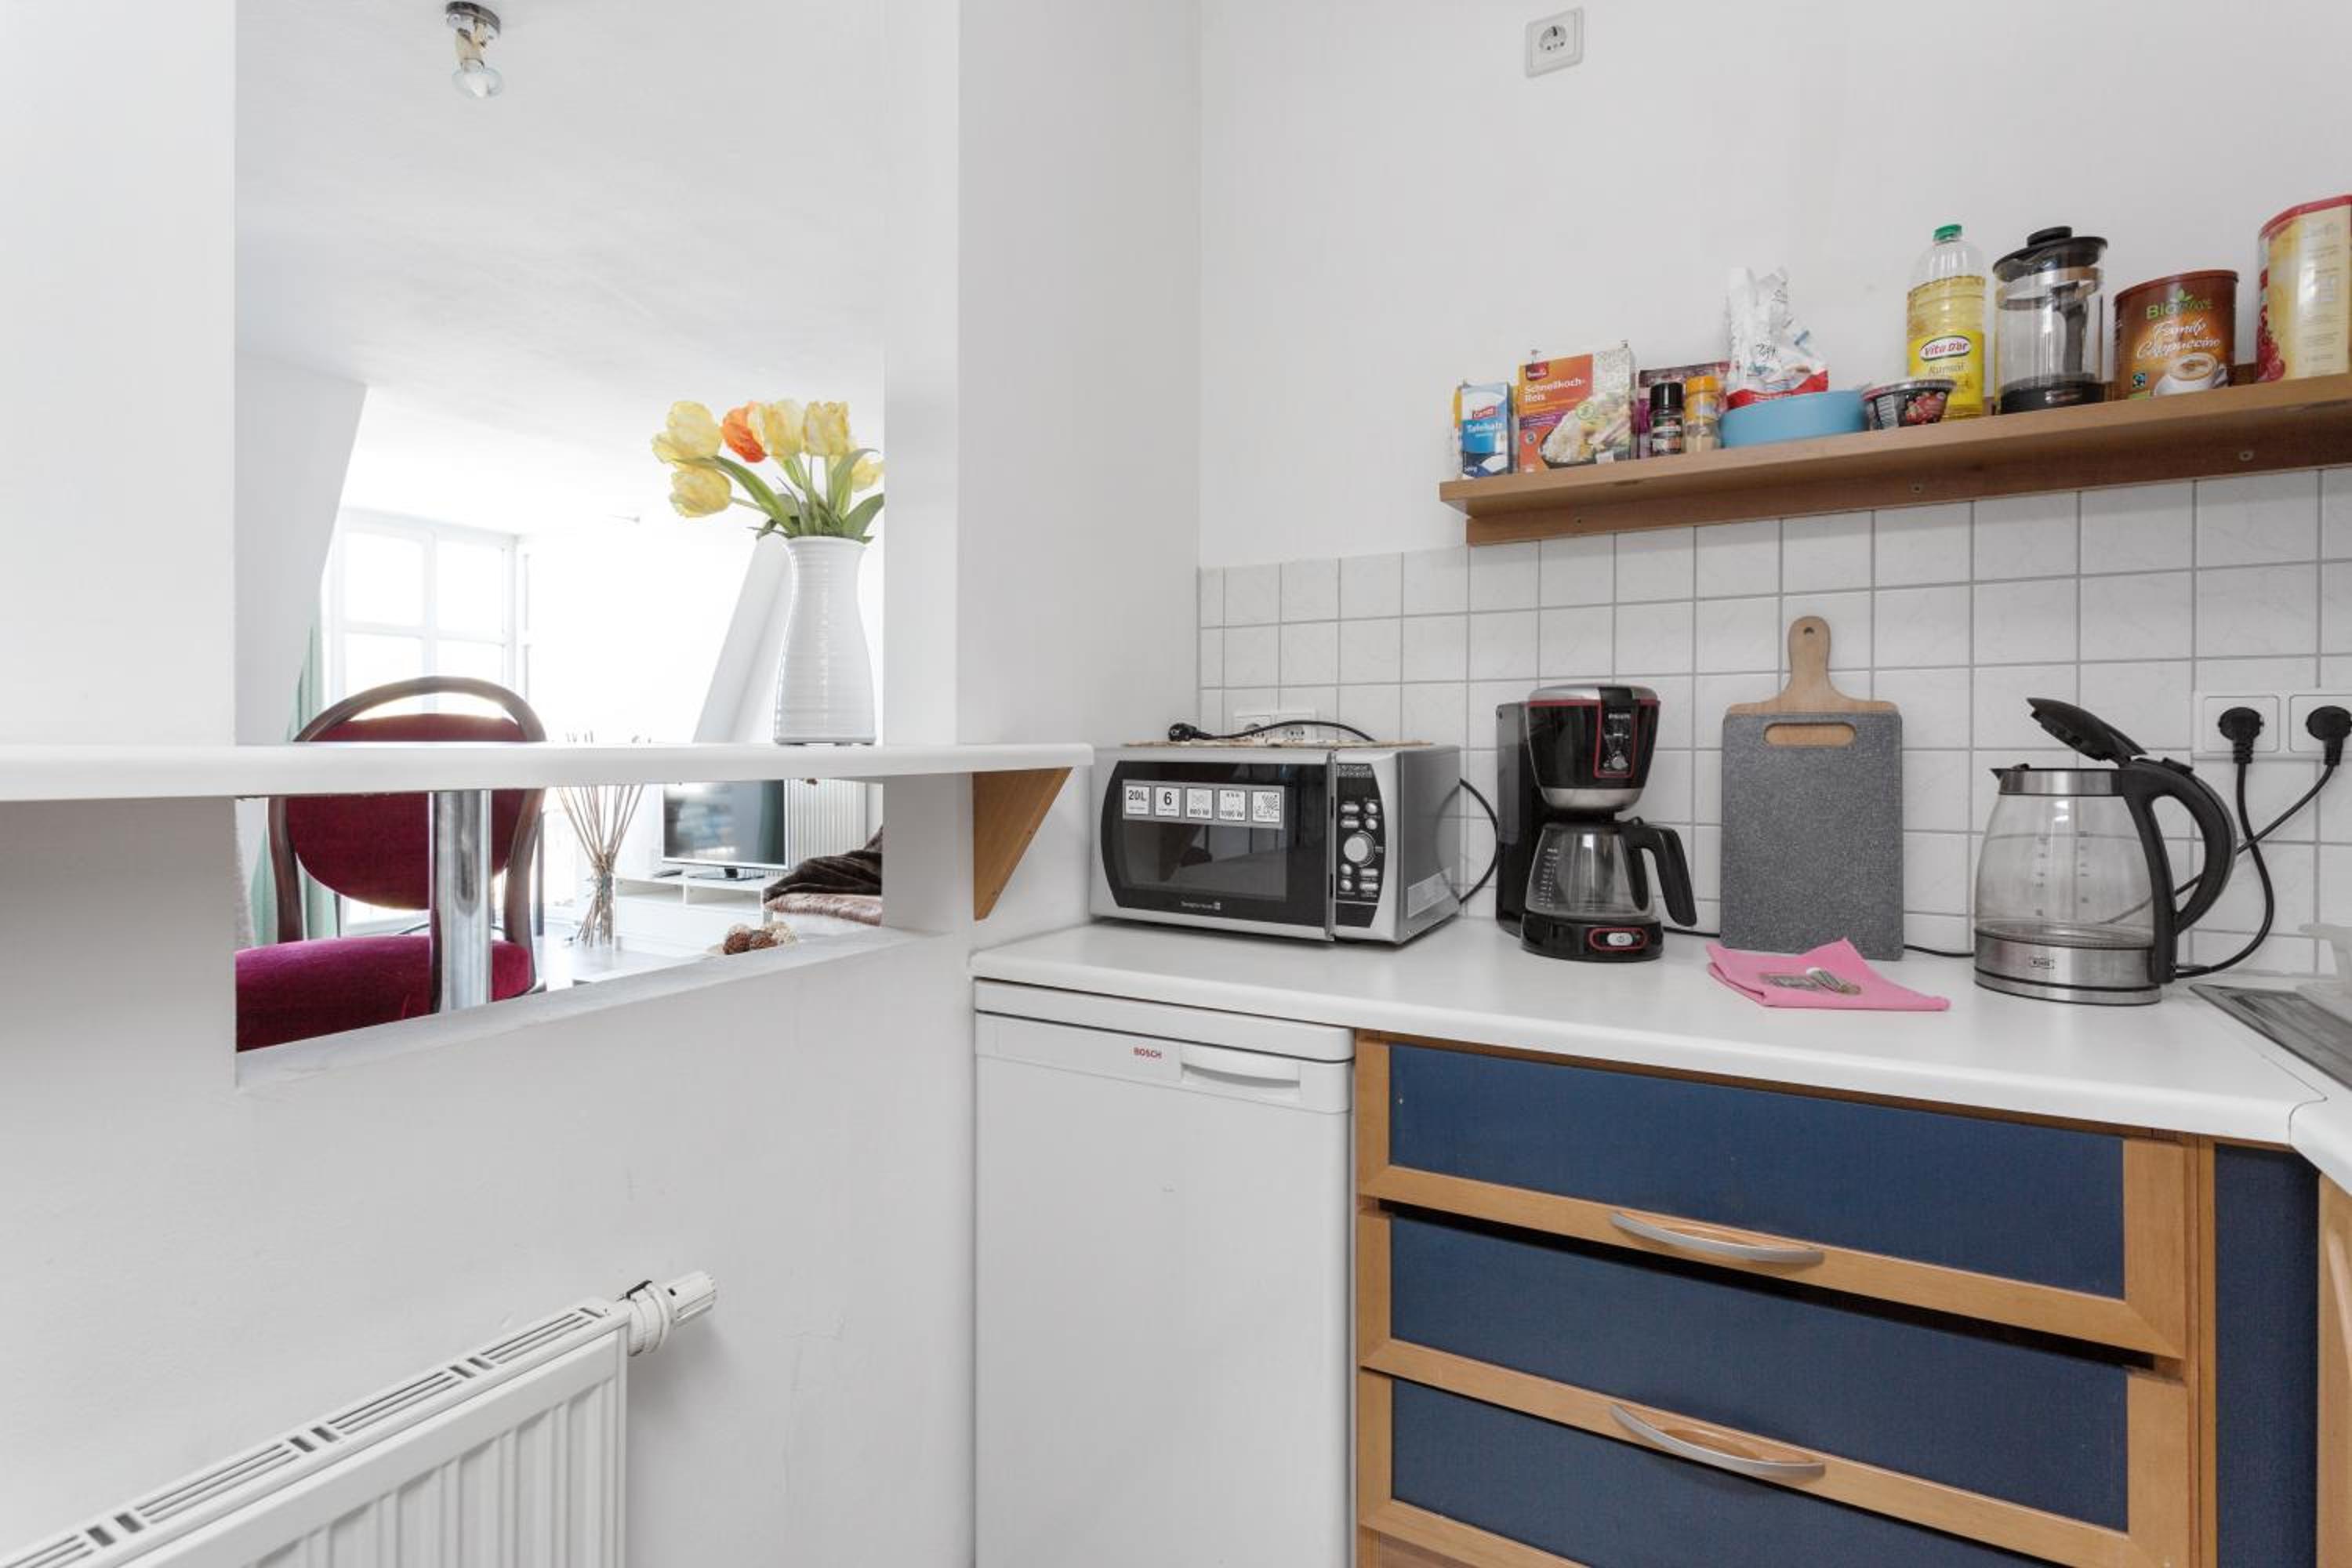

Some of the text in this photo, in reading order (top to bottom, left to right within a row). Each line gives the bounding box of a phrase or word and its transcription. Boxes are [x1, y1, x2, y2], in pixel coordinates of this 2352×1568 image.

[1925, 344, 1946, 356] Vita
[1128, 789, 1147, 801] 20L
[1163, 791, 1173, 805] 6
[1134, 1047, 1163, 1059] BOSCH
